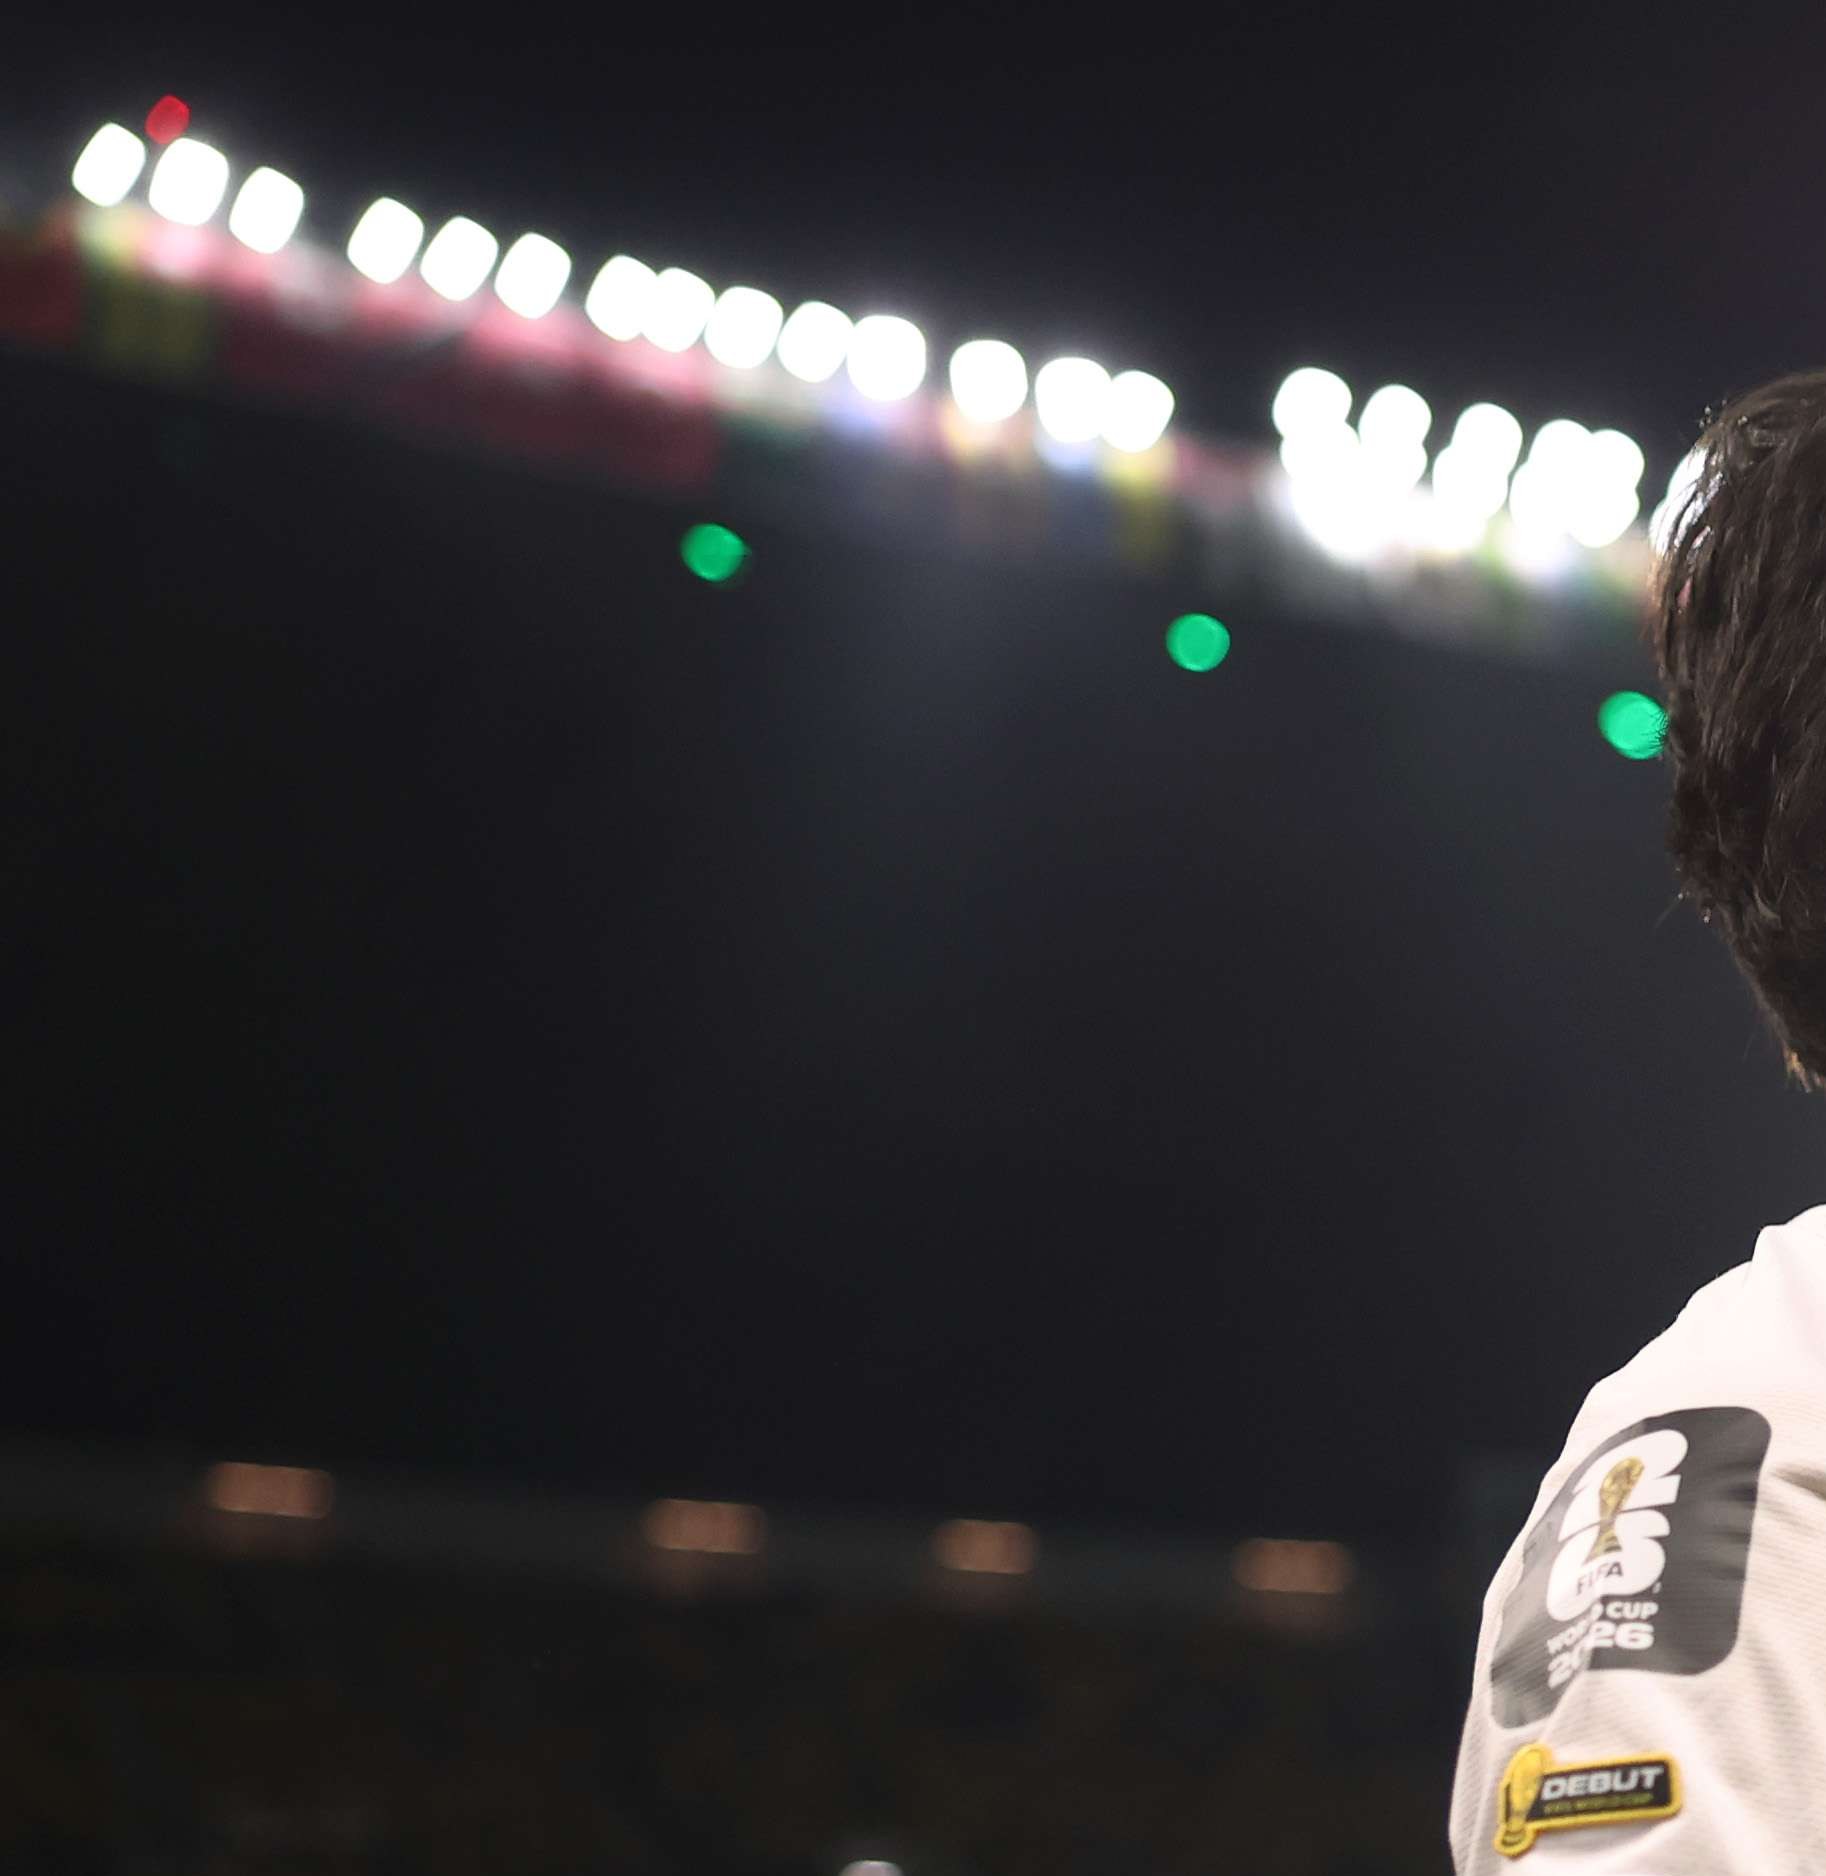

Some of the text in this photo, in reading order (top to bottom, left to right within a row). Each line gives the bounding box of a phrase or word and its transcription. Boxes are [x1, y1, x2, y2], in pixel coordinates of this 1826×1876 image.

[1577, 1561, 1624, 1597] FIFA
[1605, 1601, 1659, 1620] CUP
[1541, 1765, 1665, 1801] DEBUT
